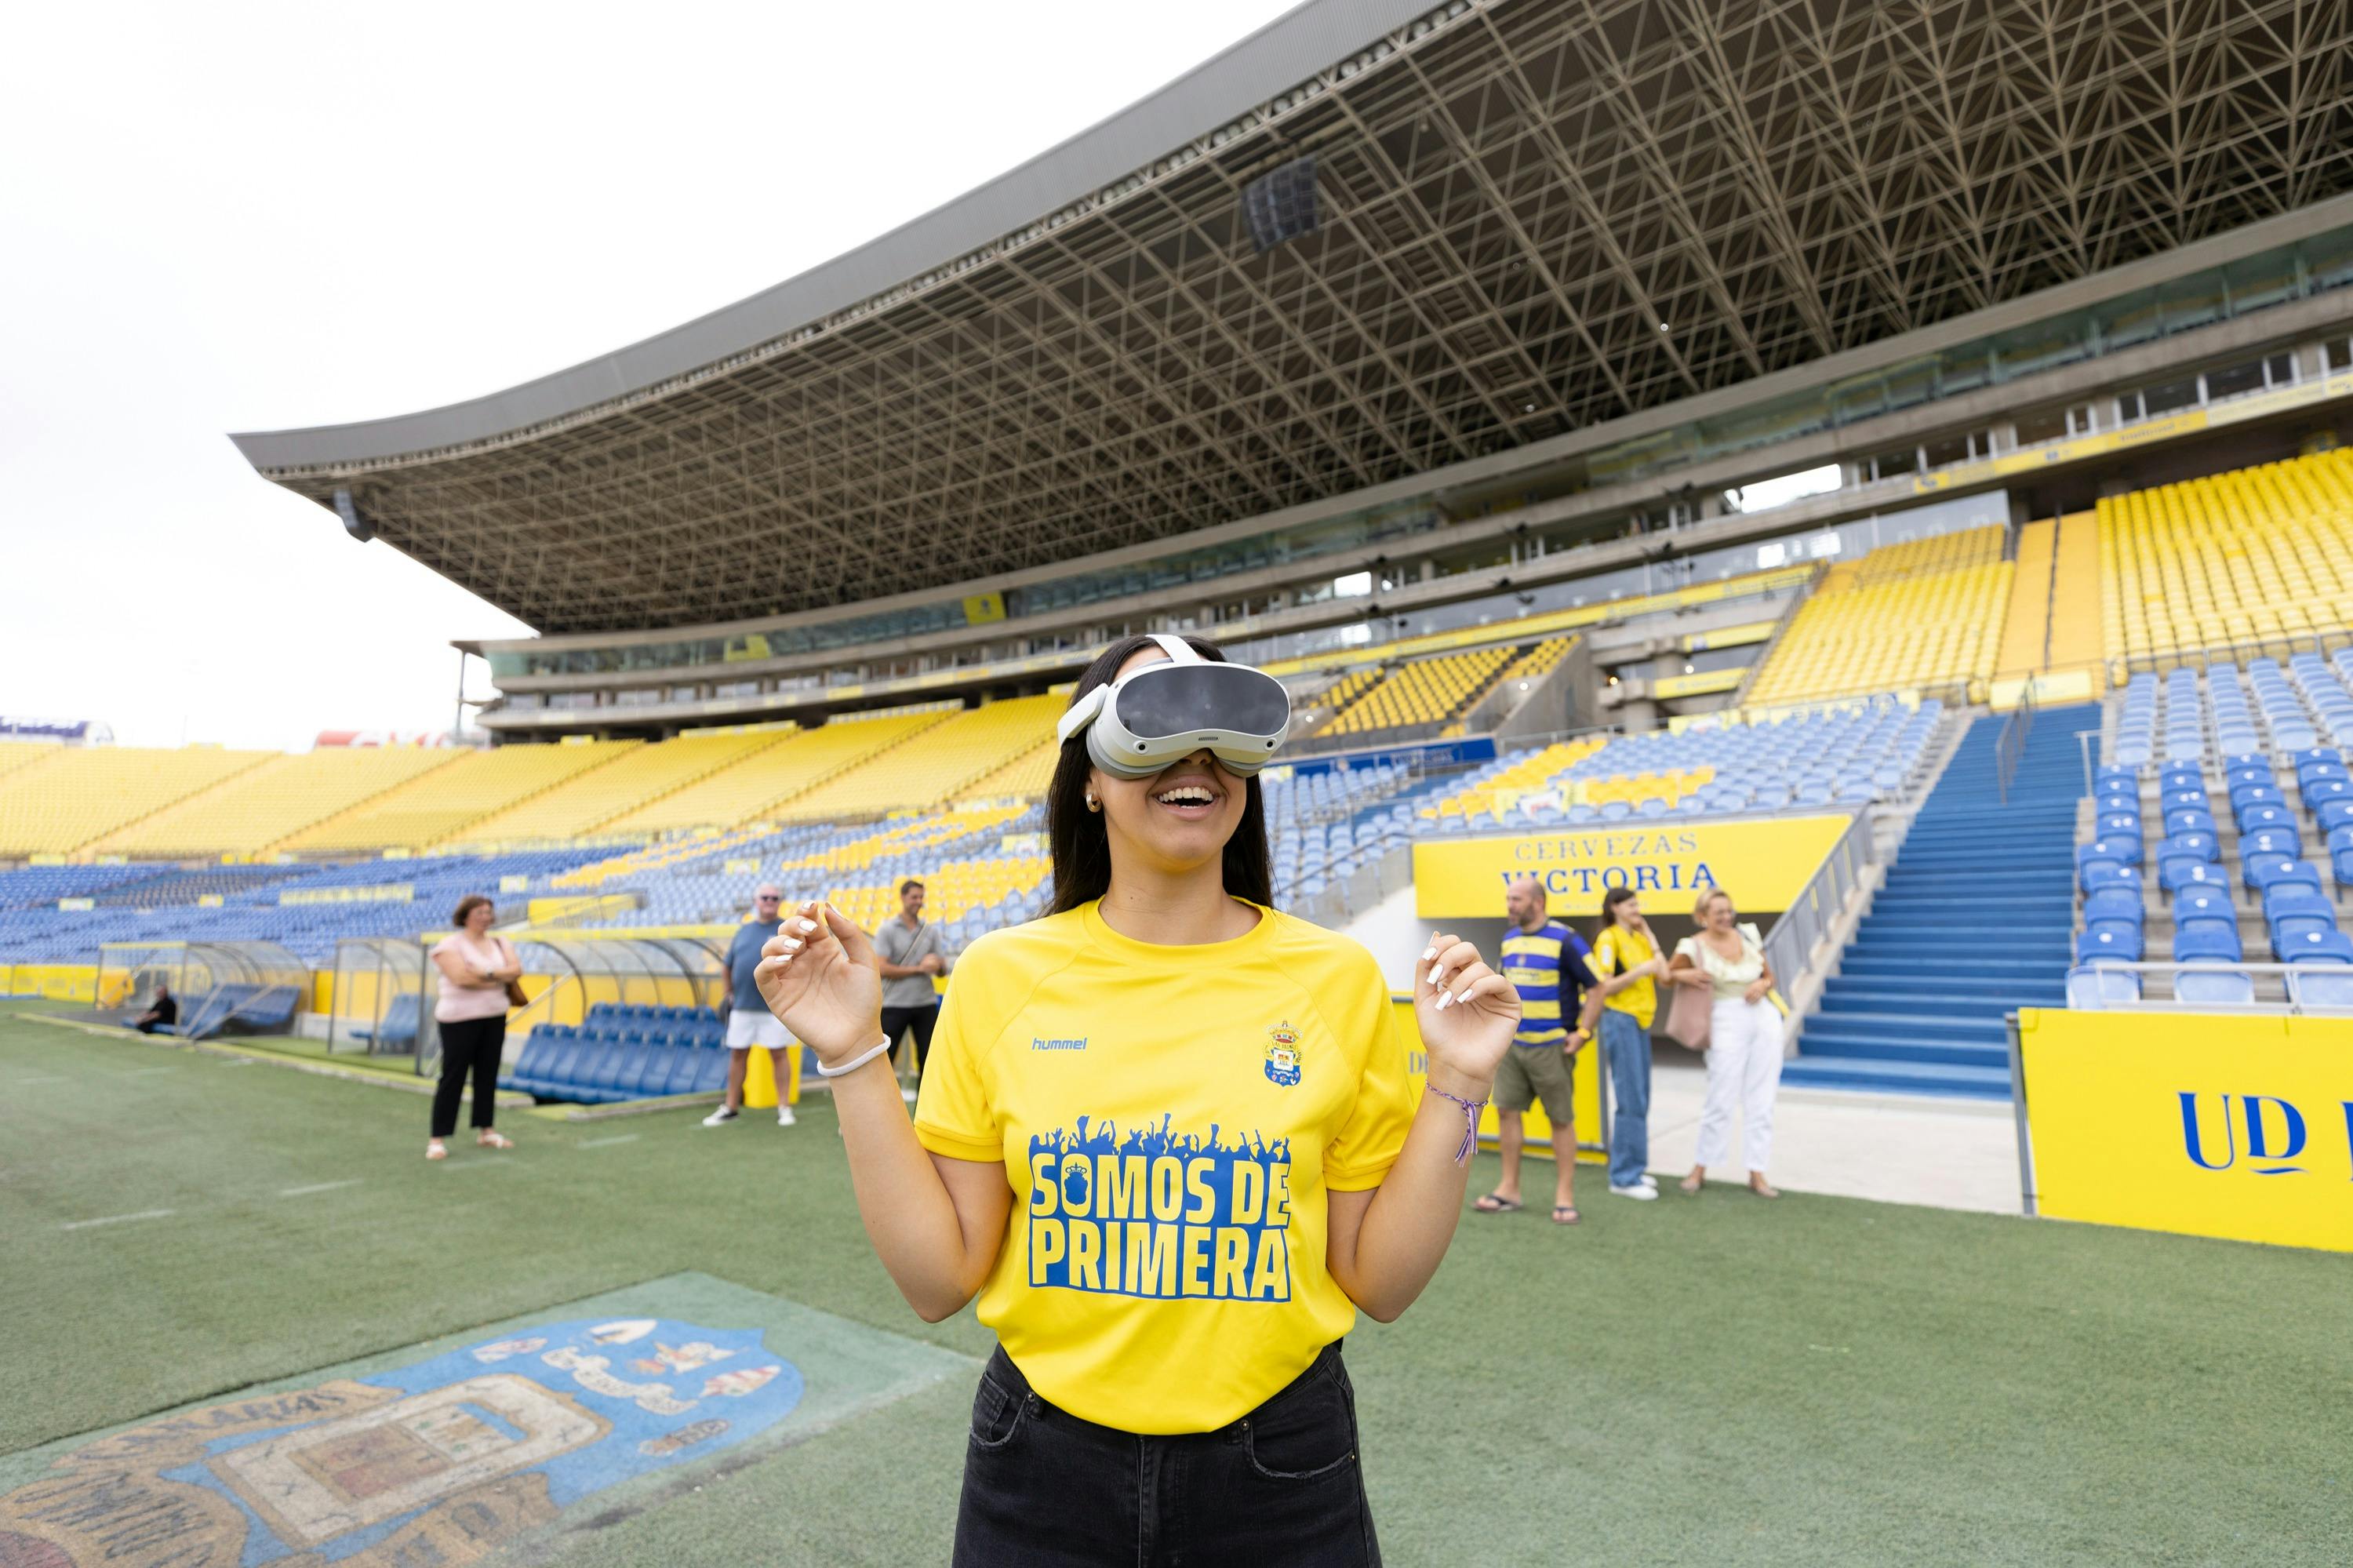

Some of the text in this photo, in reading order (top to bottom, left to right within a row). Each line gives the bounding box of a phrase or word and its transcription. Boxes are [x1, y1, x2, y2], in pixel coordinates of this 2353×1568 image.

[1515, 832, 1697, 861] CERVEZAS
[1031, 1037, 1088, 1050] hummel
[2177, 1091, 2307, 1173] UD
[1031, 1152, 1290, 1227] SOMOS DE
[1031, 1218, 1289, 1299] PRIMERA
